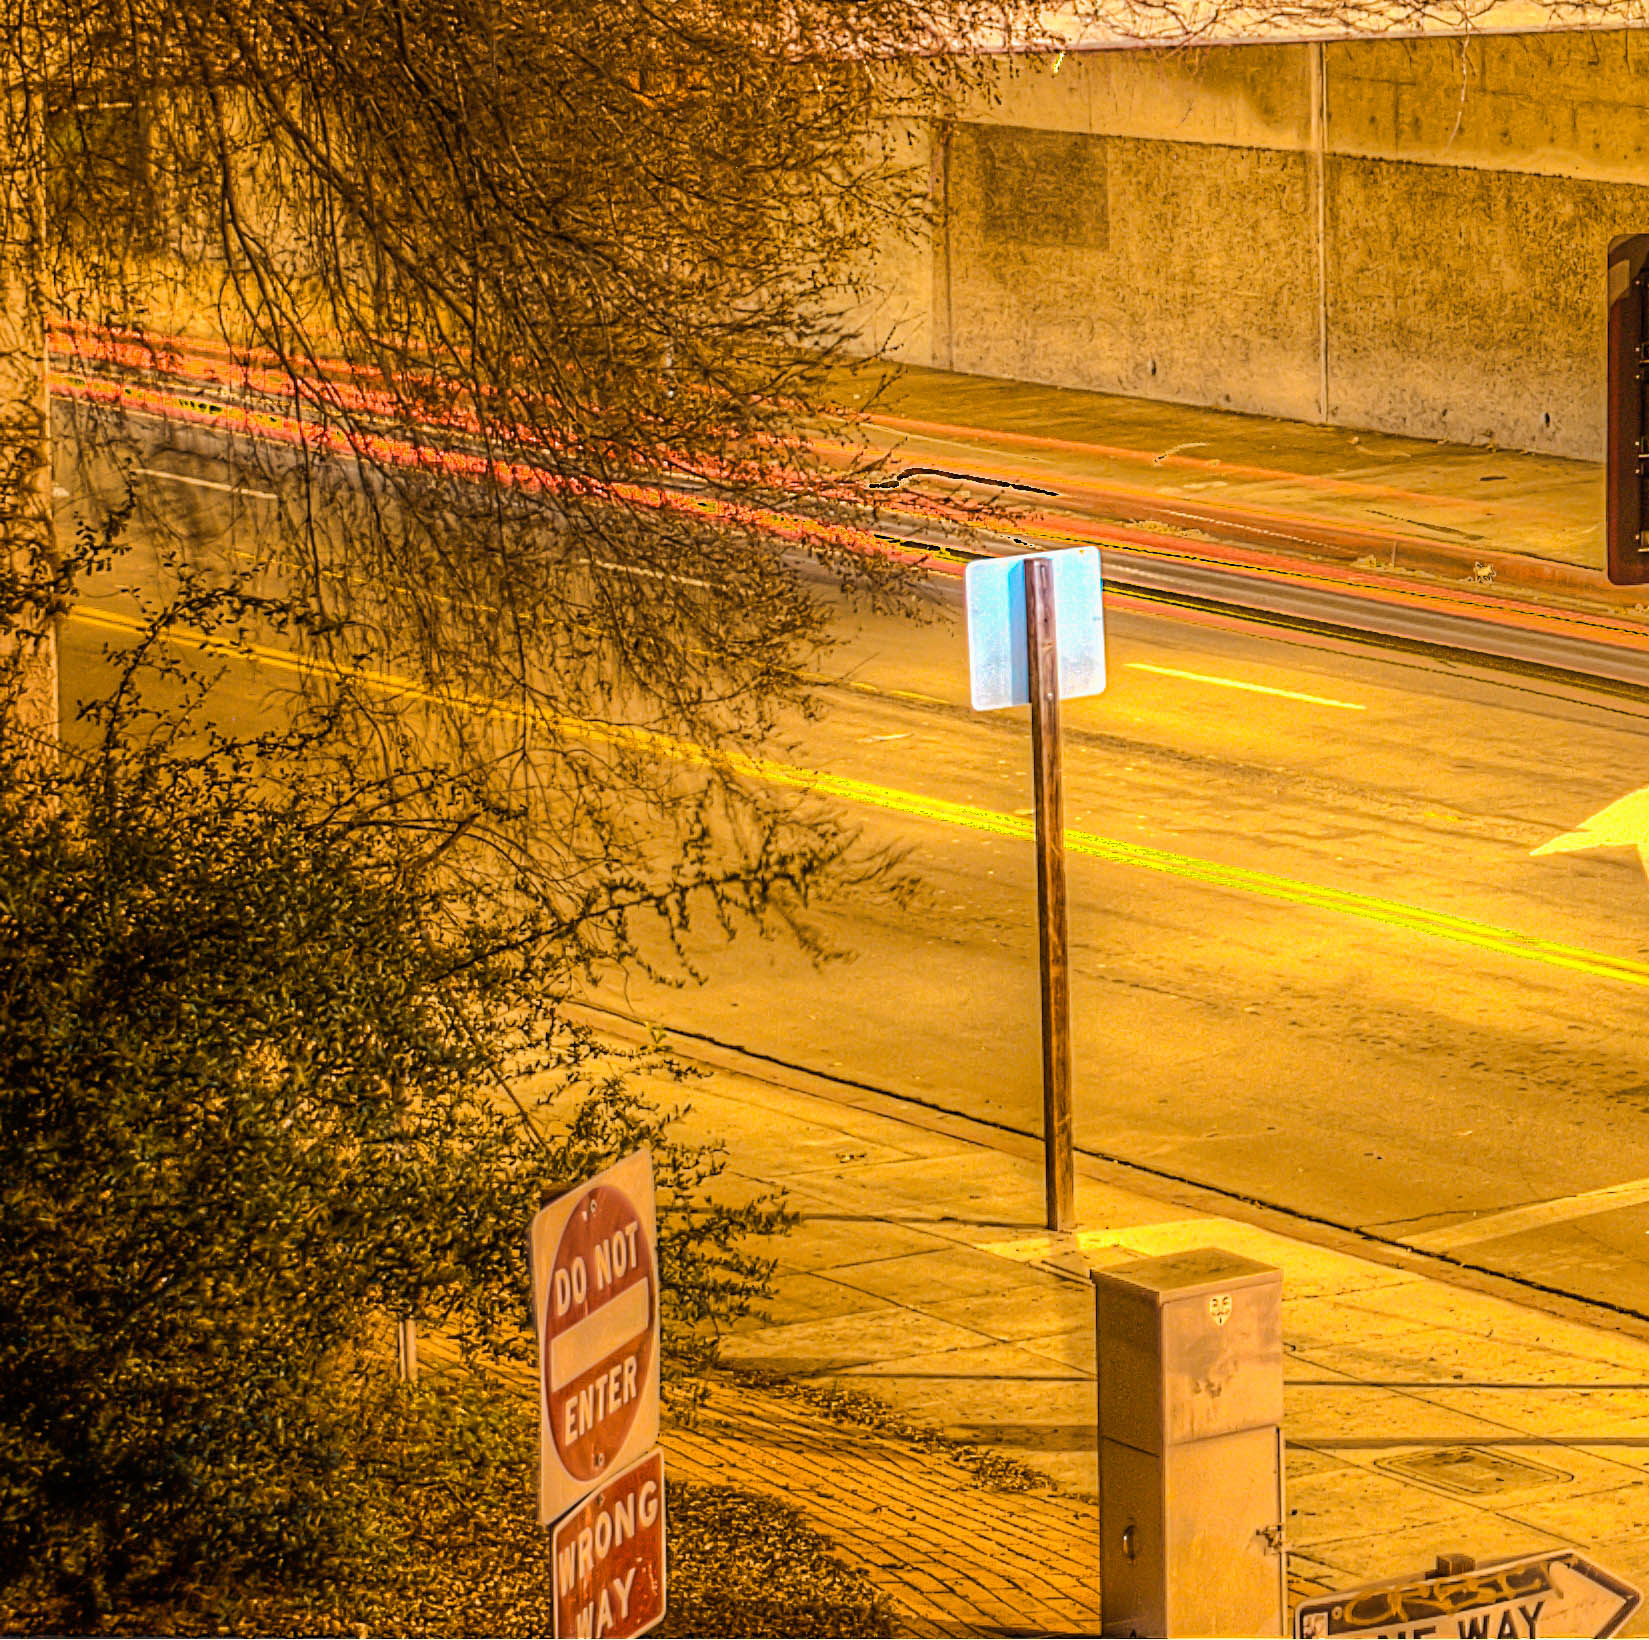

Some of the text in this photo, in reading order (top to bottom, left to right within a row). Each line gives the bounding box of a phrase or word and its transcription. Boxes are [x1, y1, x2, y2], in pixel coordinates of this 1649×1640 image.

[554, 1220, 639, 1317] DO NOT
[564, 1355, 638, 1447] ENTER
[558, 1480, 659, 1598] WRONG
[575, 1567, 636, 1639] WAY
